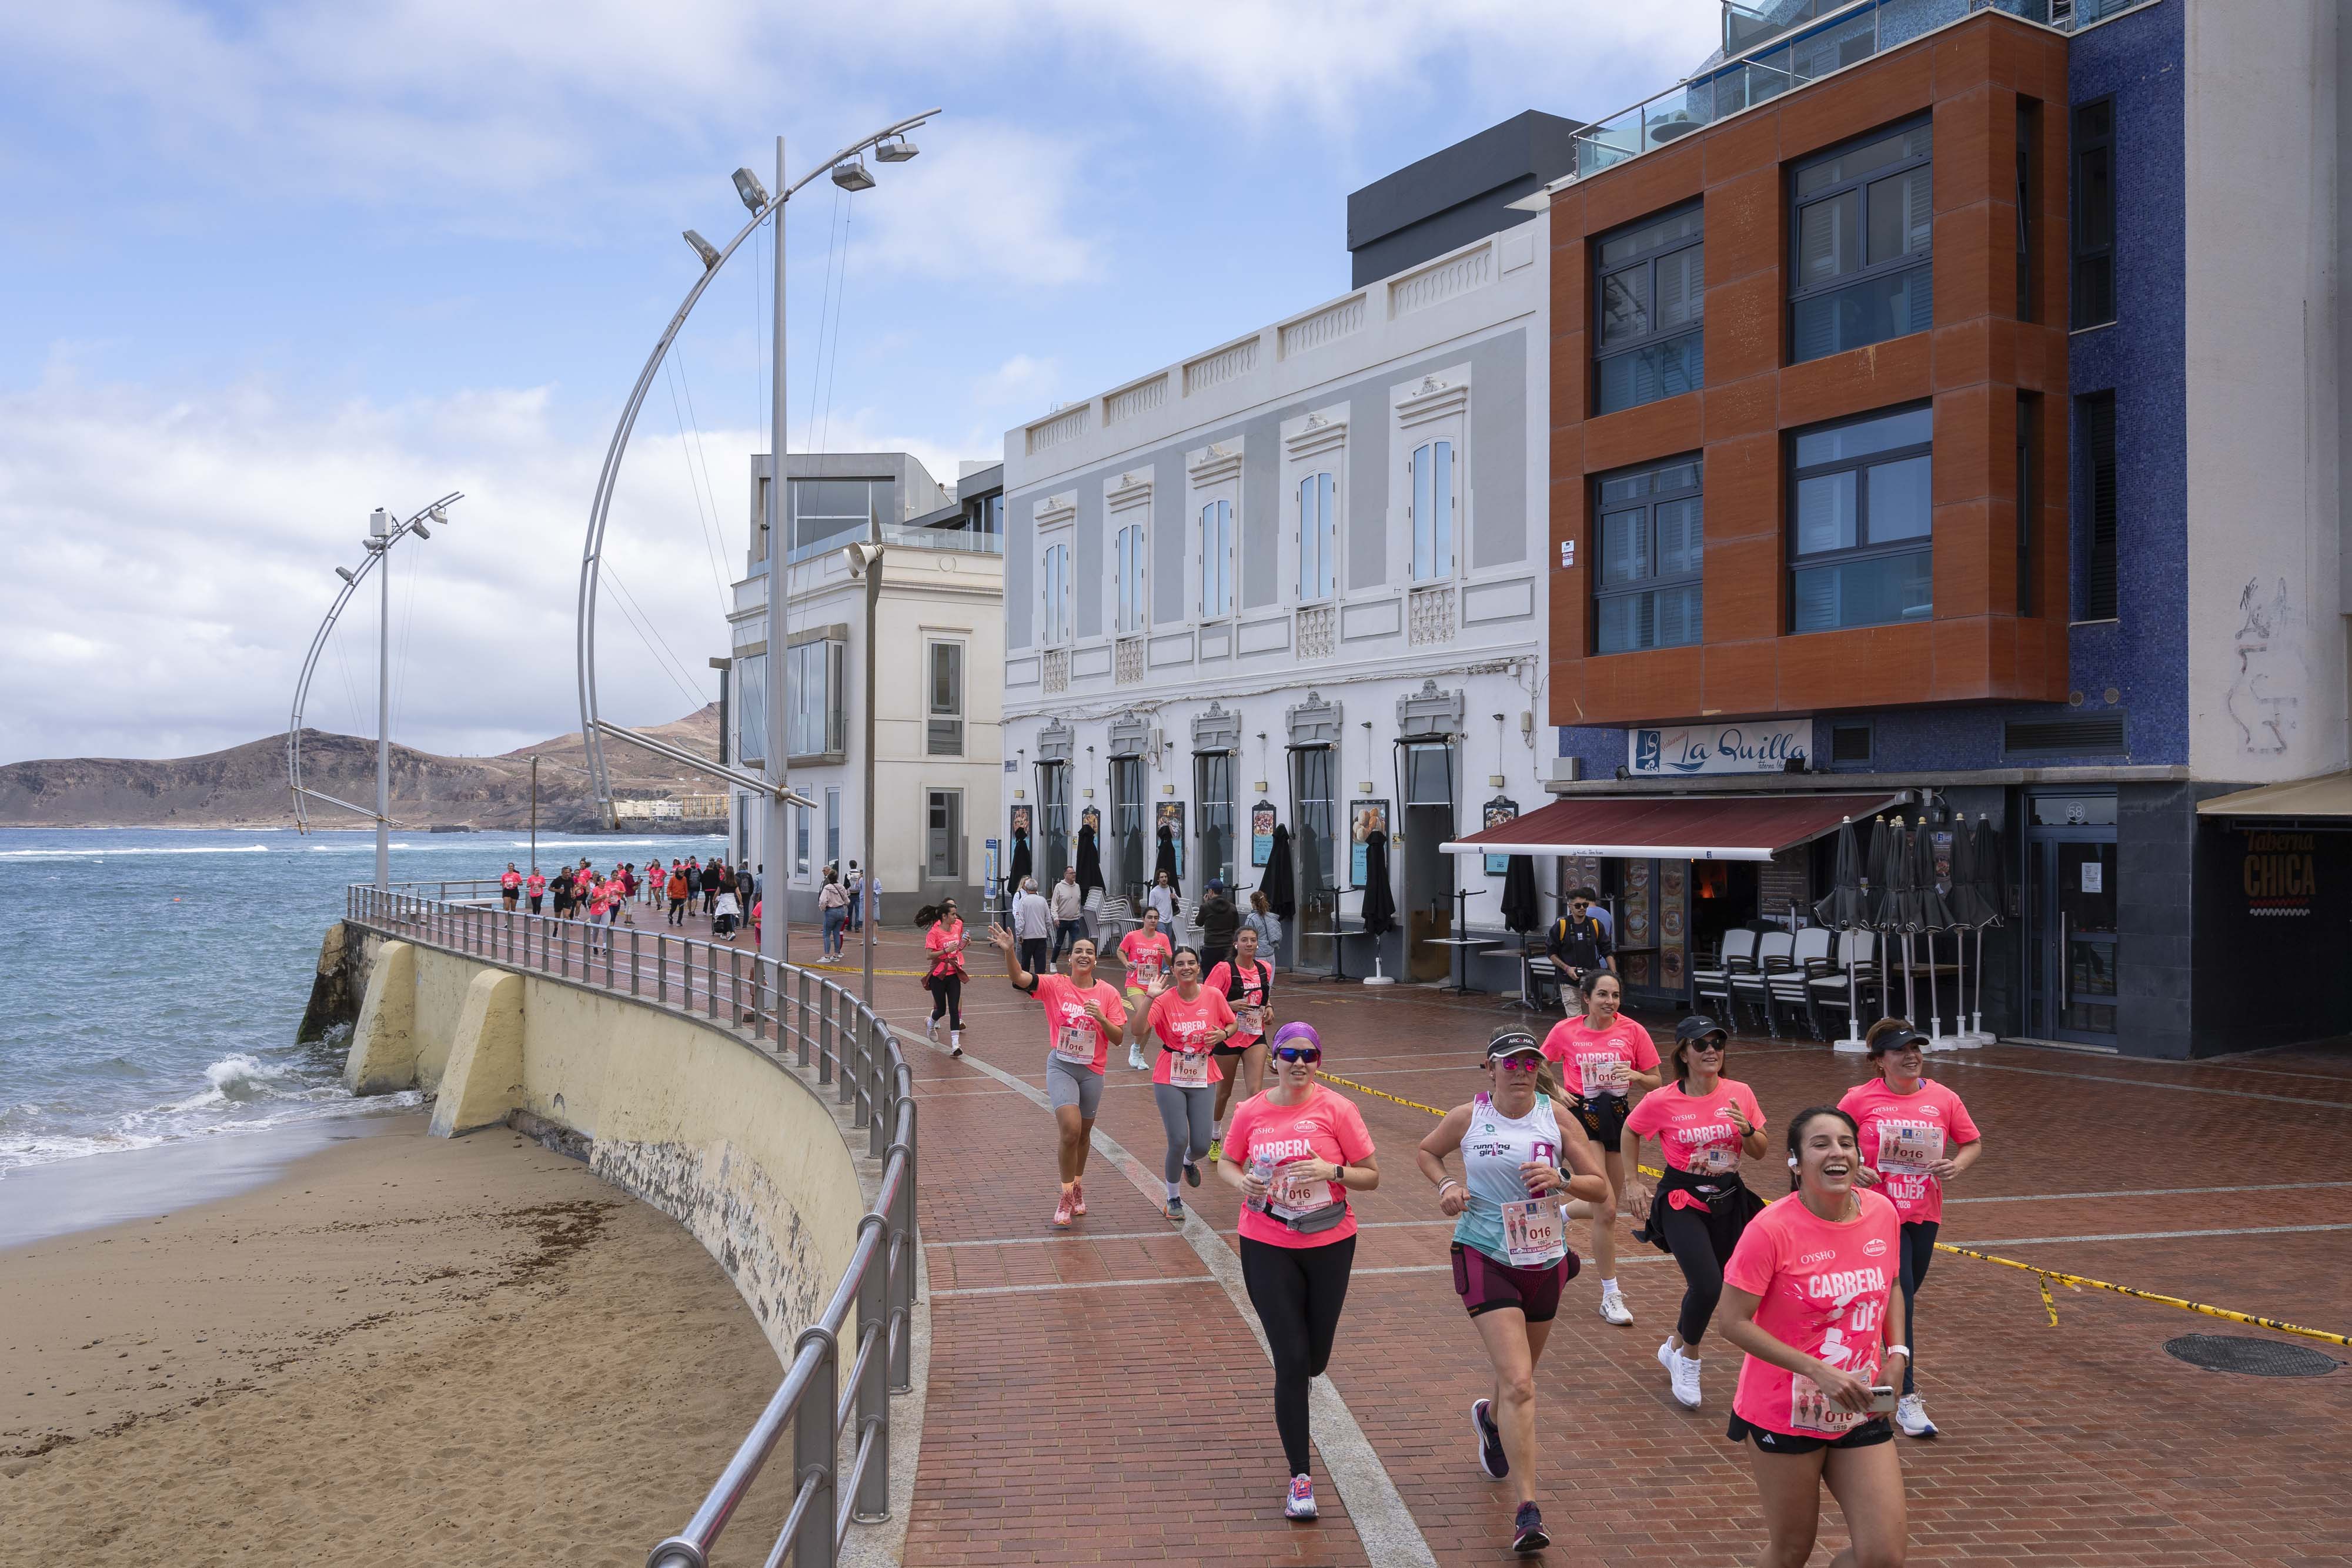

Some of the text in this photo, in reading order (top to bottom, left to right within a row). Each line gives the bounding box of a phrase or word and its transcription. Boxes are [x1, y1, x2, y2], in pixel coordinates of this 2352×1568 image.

[1662, 728, 1810, 772] La Quilla
[2068, 806, 2083, 817] 58
[2244, 854, 2317, 897] CHICA
[1172, 1020, 1207, 1032] CARRERA
[1576, 1052, 1621, 1065] CARRERA
[1671, 1114, 1696, 1122] OYSHO
[1678, 1124, 1733, 1144] CARRERA
[1253, 1138, 1311, 1161] CARRERA
[1474, 1142, 1510, 1151] running
[1900, 1149, 1923, 1158] 016
[1289, 1189, 1311, 1200] 016
[1887, 1183, 1925, 1200] MUJER
[1529, 1226, 1551, 1239] 016
[1800, 1250, 1836, 1265] OYSHO
[1809, 1266, 1886, 1298] CARRERA
